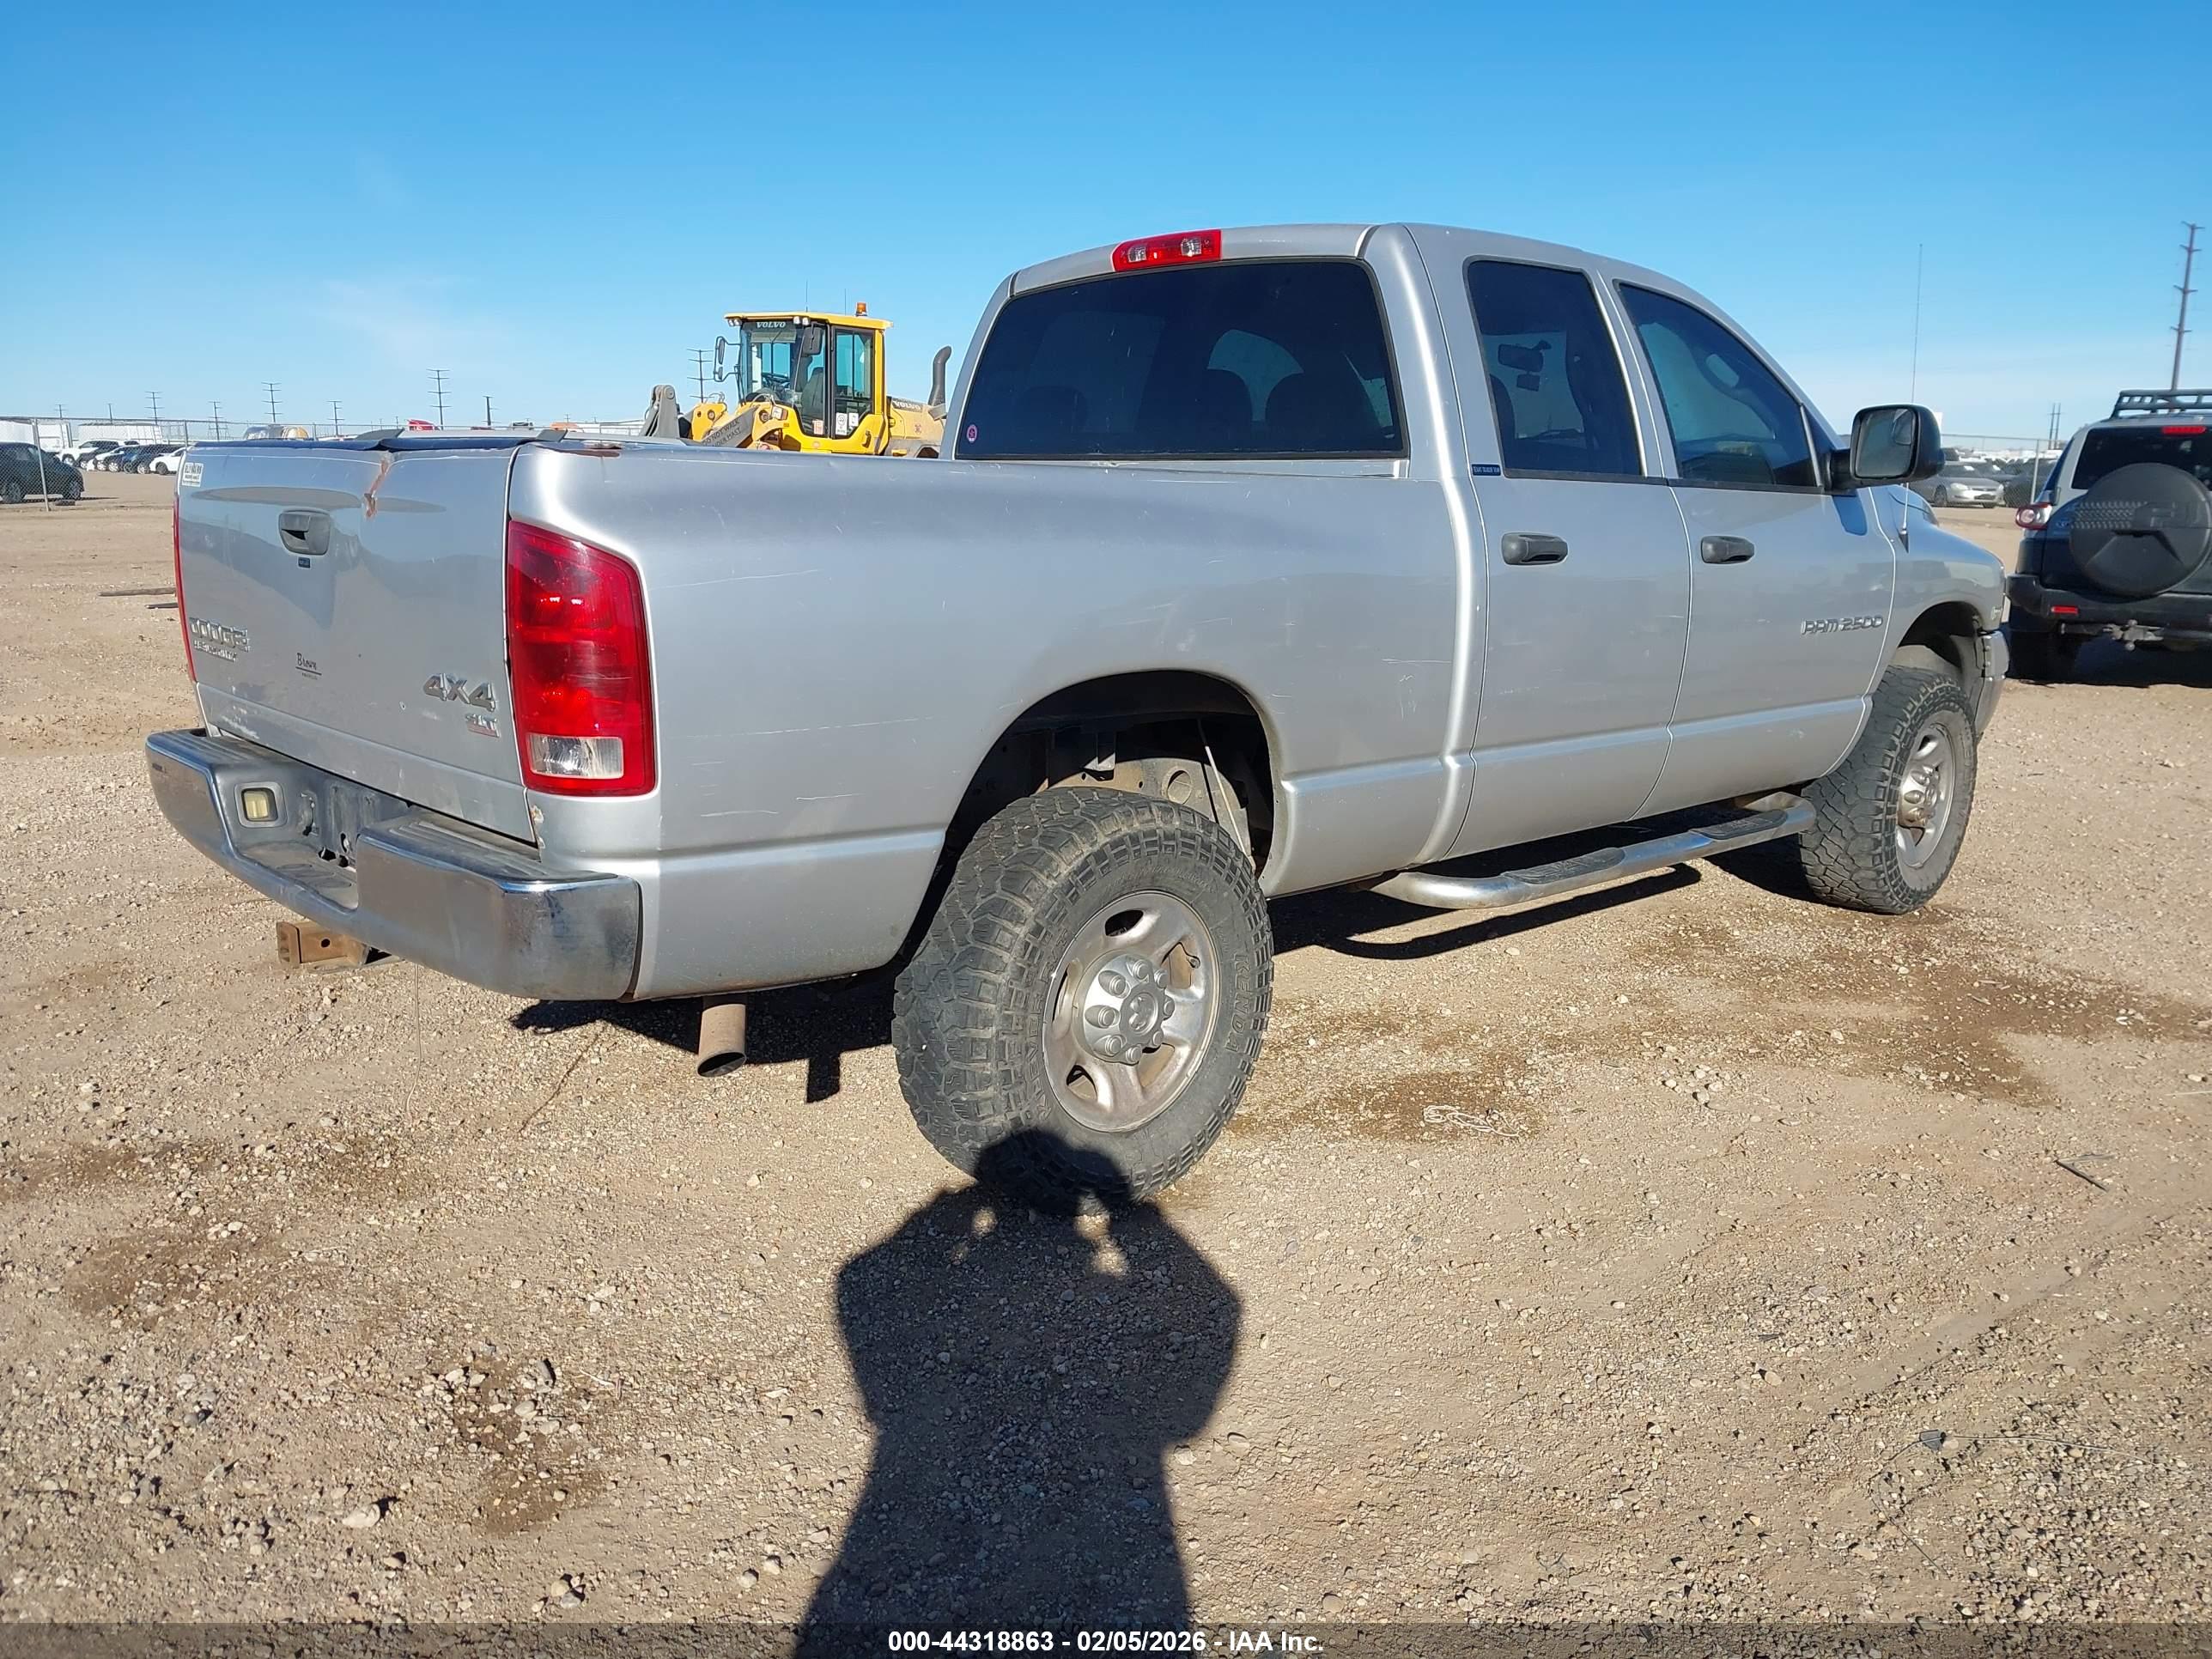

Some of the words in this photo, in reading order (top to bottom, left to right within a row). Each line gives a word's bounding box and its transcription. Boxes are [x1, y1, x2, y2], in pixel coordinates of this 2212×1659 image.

[892, 400, 921, 410] VOLVO
[189, 617, 250, 653] DODGE
[1801, 620, 1838, 635] RAM
[1838, 616, 1884, 632] 2500
[1224, 951, 1252, 1053] KENDA
